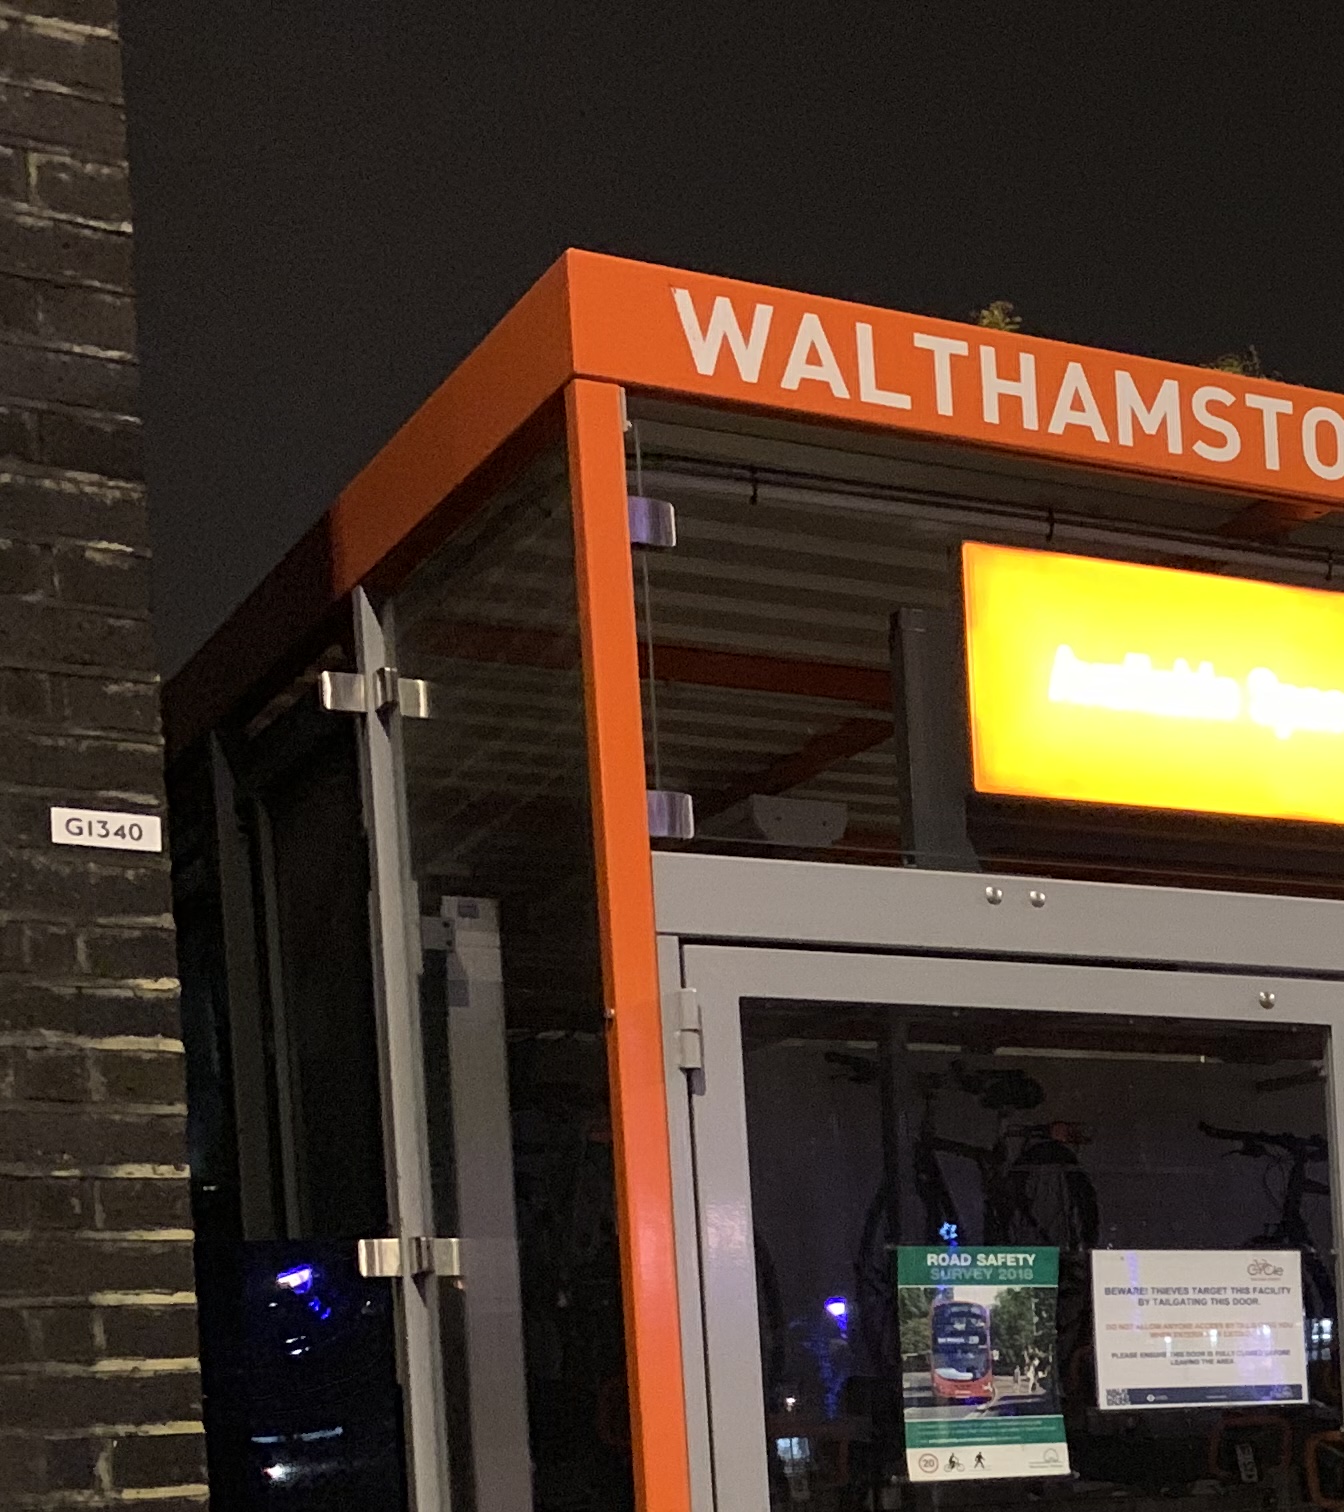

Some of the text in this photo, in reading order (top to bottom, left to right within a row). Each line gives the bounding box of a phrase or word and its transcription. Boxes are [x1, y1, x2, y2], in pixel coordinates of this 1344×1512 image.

[927, 1253, 1036, 1266] ROAD SAFETY
[930, 1268, 993, 1281] SURVEY
[1150, 1286, 1189, 1295] THIEVES
[1192, 1286, 1227, 1295] TARGET
[1230, 1286, 1250, 1295] THIS
[1253, 1286, 1291, 1295] FACILITY
[1138, 1298, 1150, 1306] BY
[1153, 1297, 1208, 1306] TAILGATING
[1210, 1297, 1230, 1306] THIS
[923, 1458, 935, 1468] 20
